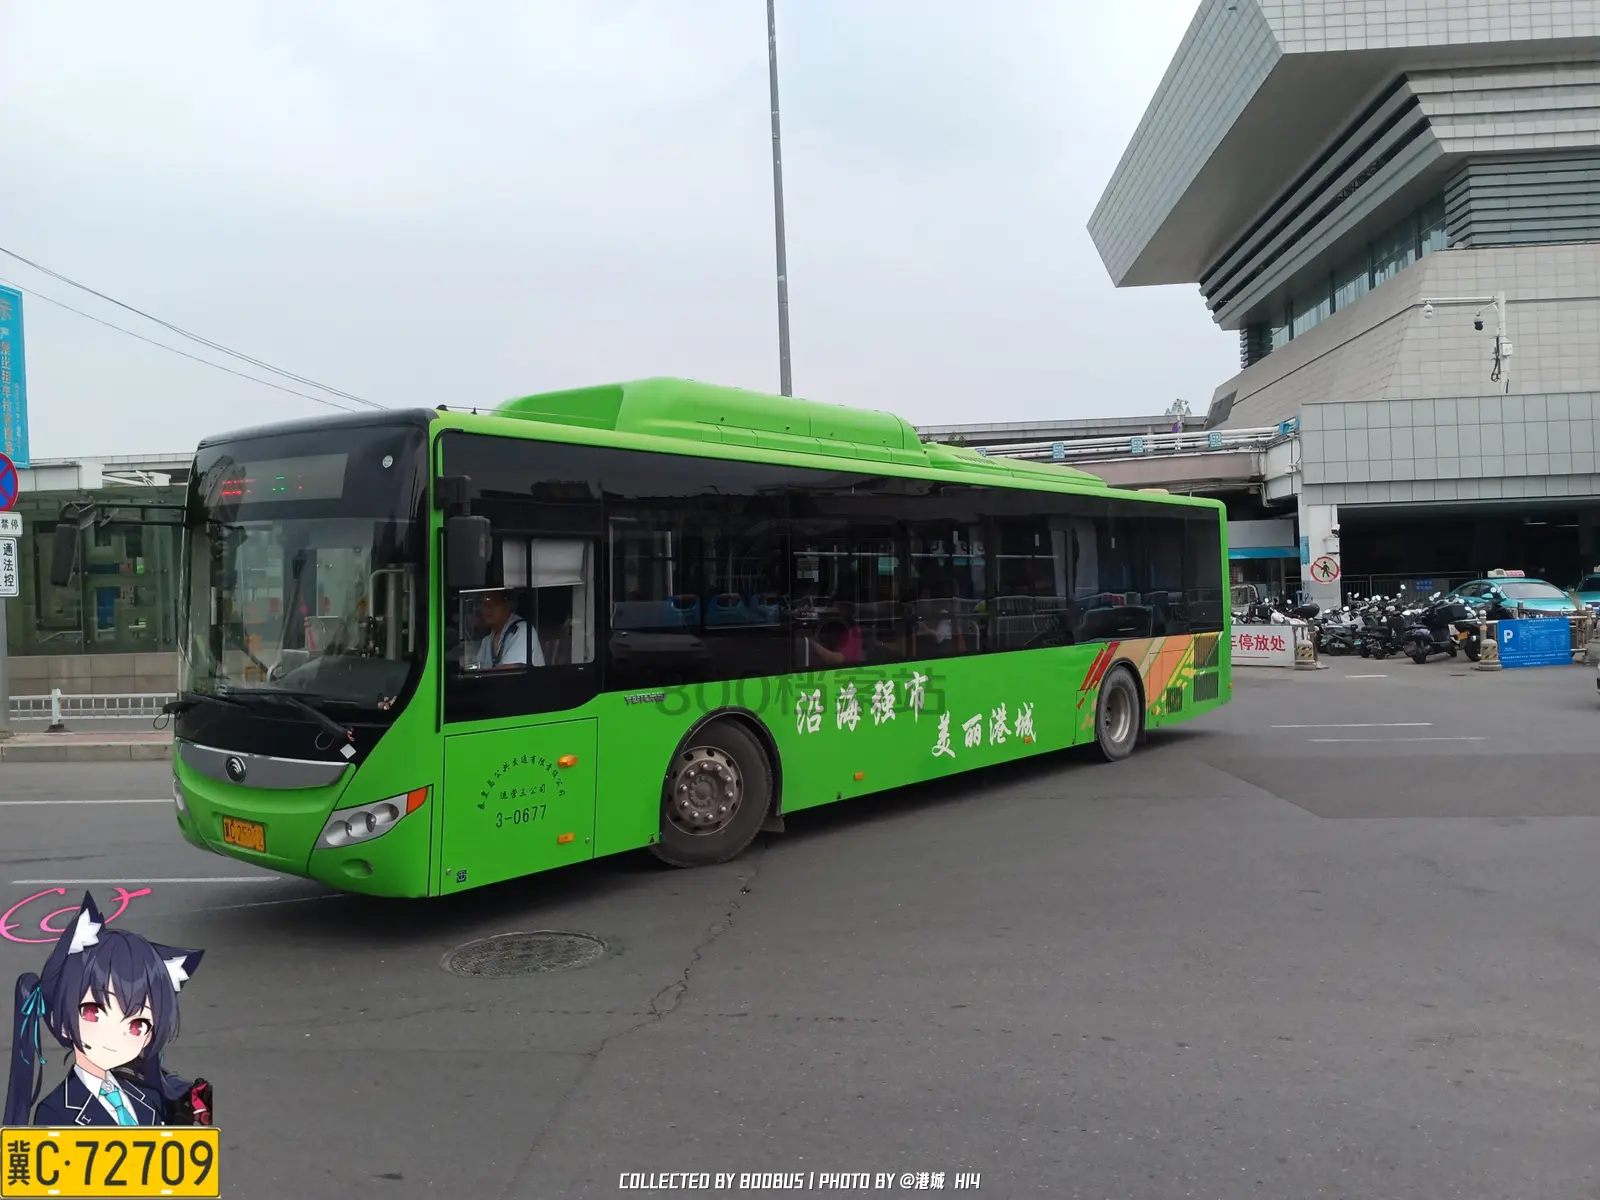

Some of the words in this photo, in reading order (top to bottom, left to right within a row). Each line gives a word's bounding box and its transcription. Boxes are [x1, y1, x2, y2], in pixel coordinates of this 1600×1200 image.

[1, 518, 19, 530] 禁停
[1503, 629, 1514, 644] P
[796, 671, 930, 735] 沿海强市
[931, 702, 1037, 759] 美丽港城
[499, 783, 546, 800] 运营三公司
[495, 804, 547, 829] 3-0677
